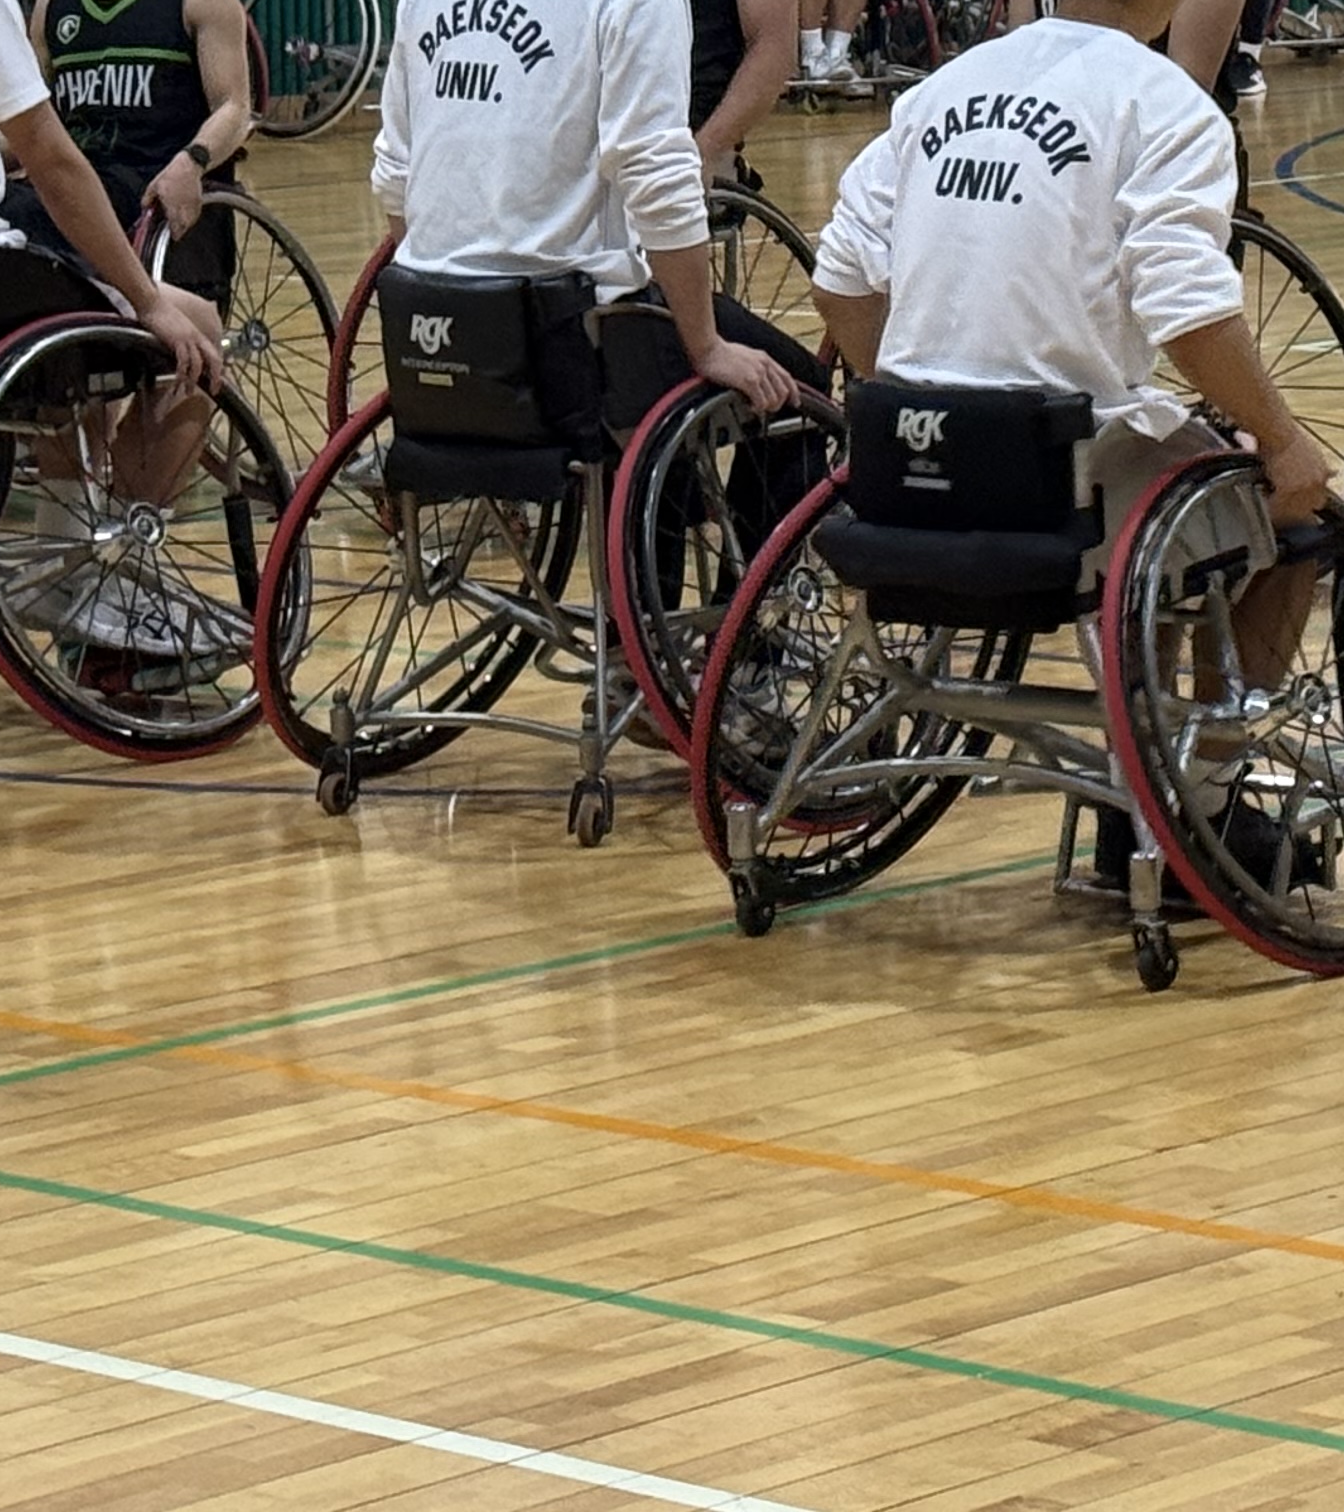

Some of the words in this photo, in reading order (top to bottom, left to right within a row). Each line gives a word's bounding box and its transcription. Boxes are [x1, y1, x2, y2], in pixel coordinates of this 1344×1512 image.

[435, 61, 503, 104] UNIV.
[920, 93, 1091, 176] BAEKSEOK
[935, 157, 1023, 205] UNIV.
